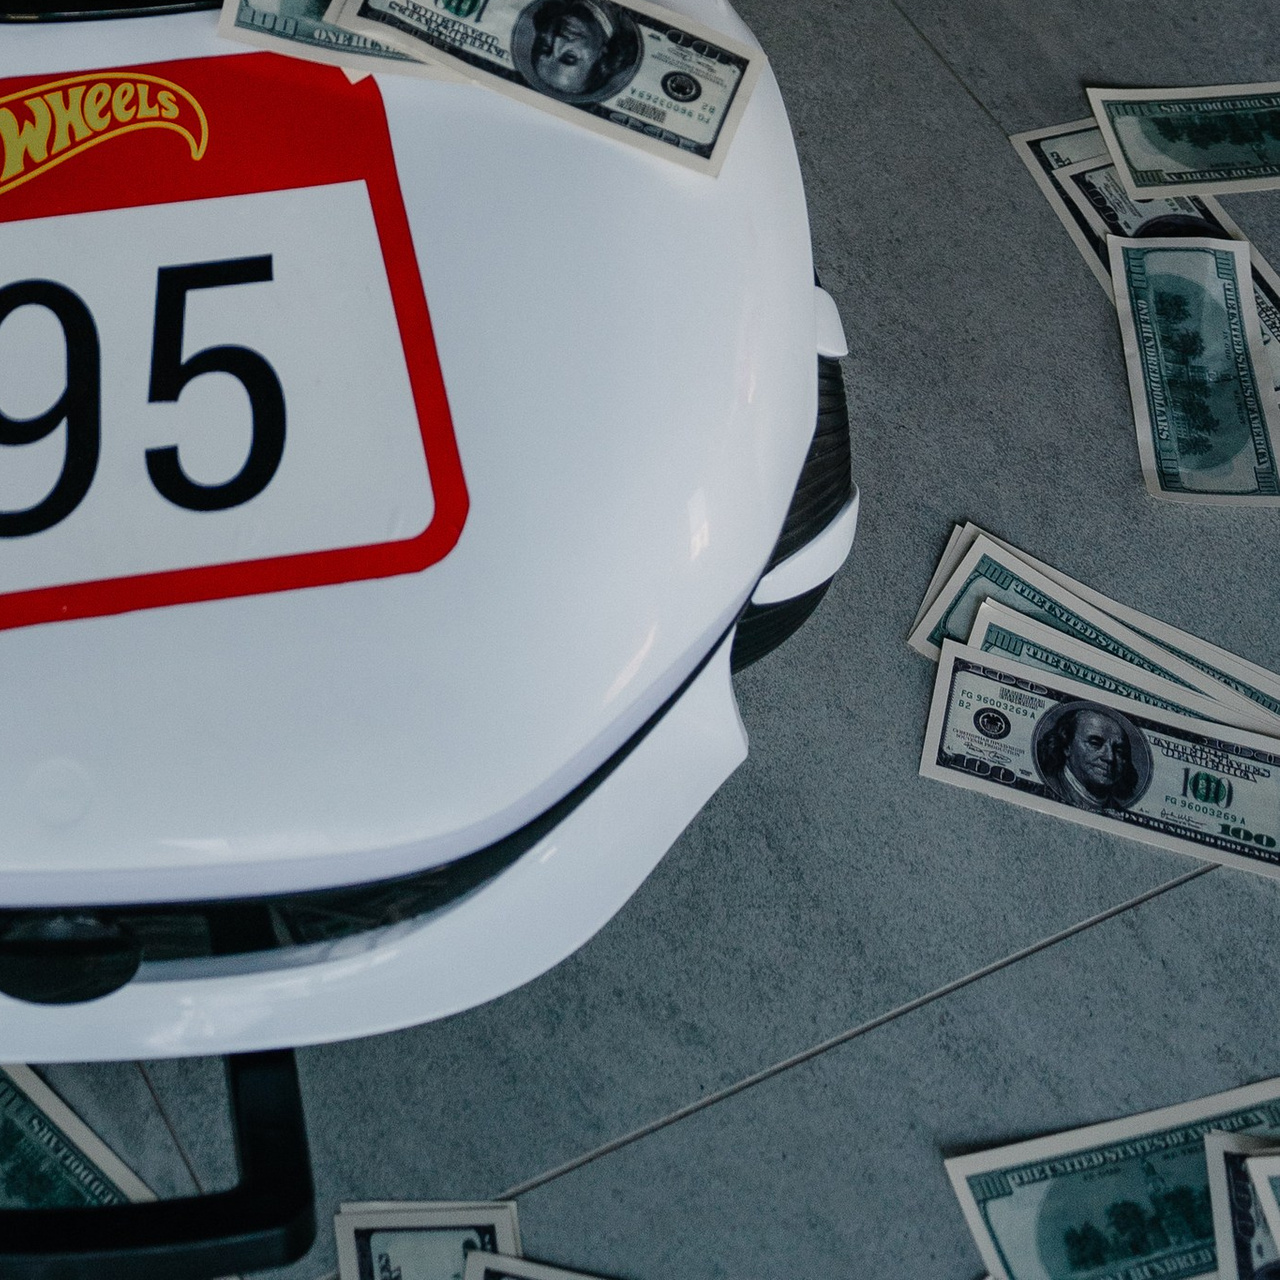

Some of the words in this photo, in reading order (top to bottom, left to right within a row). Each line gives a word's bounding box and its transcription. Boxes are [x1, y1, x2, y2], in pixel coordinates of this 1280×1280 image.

[1159, 100, 1221, 115] DOLLARS
[1136, 297, 1150, 324] ONE
[1223, 280, 1237, 310] THE
[1227, 309, 1245, 354] UNITED
[1140, 322, 1160, 381] HUNDRED
[1235, 354, 1254, 396] STATES
[1150, 381, 1170, 441] DOLLARS
[1248, 410, 1269, 466] AMERICA
[1012, 580, 1046, 607] THE
[1042, 599, 1095, 639] UNITED
[1023, 644, 1059, 666] THE
[1058, 658, 1116, 691] UNITED
[957, 699, 972, 710] B2
[960, 689, 974, 699] FG
[975, 693, 1028, 717] 96003269
[1029, 711, 1037, 720] A
[1163, 794, 1177, 805] FG
[1179, 799, 1238, 823] 96003269
[1239, 817, 1247, 825] A
[1147, 819, 1216, 844] HUNDRED
[1215, 821, 1278, 849] 100
